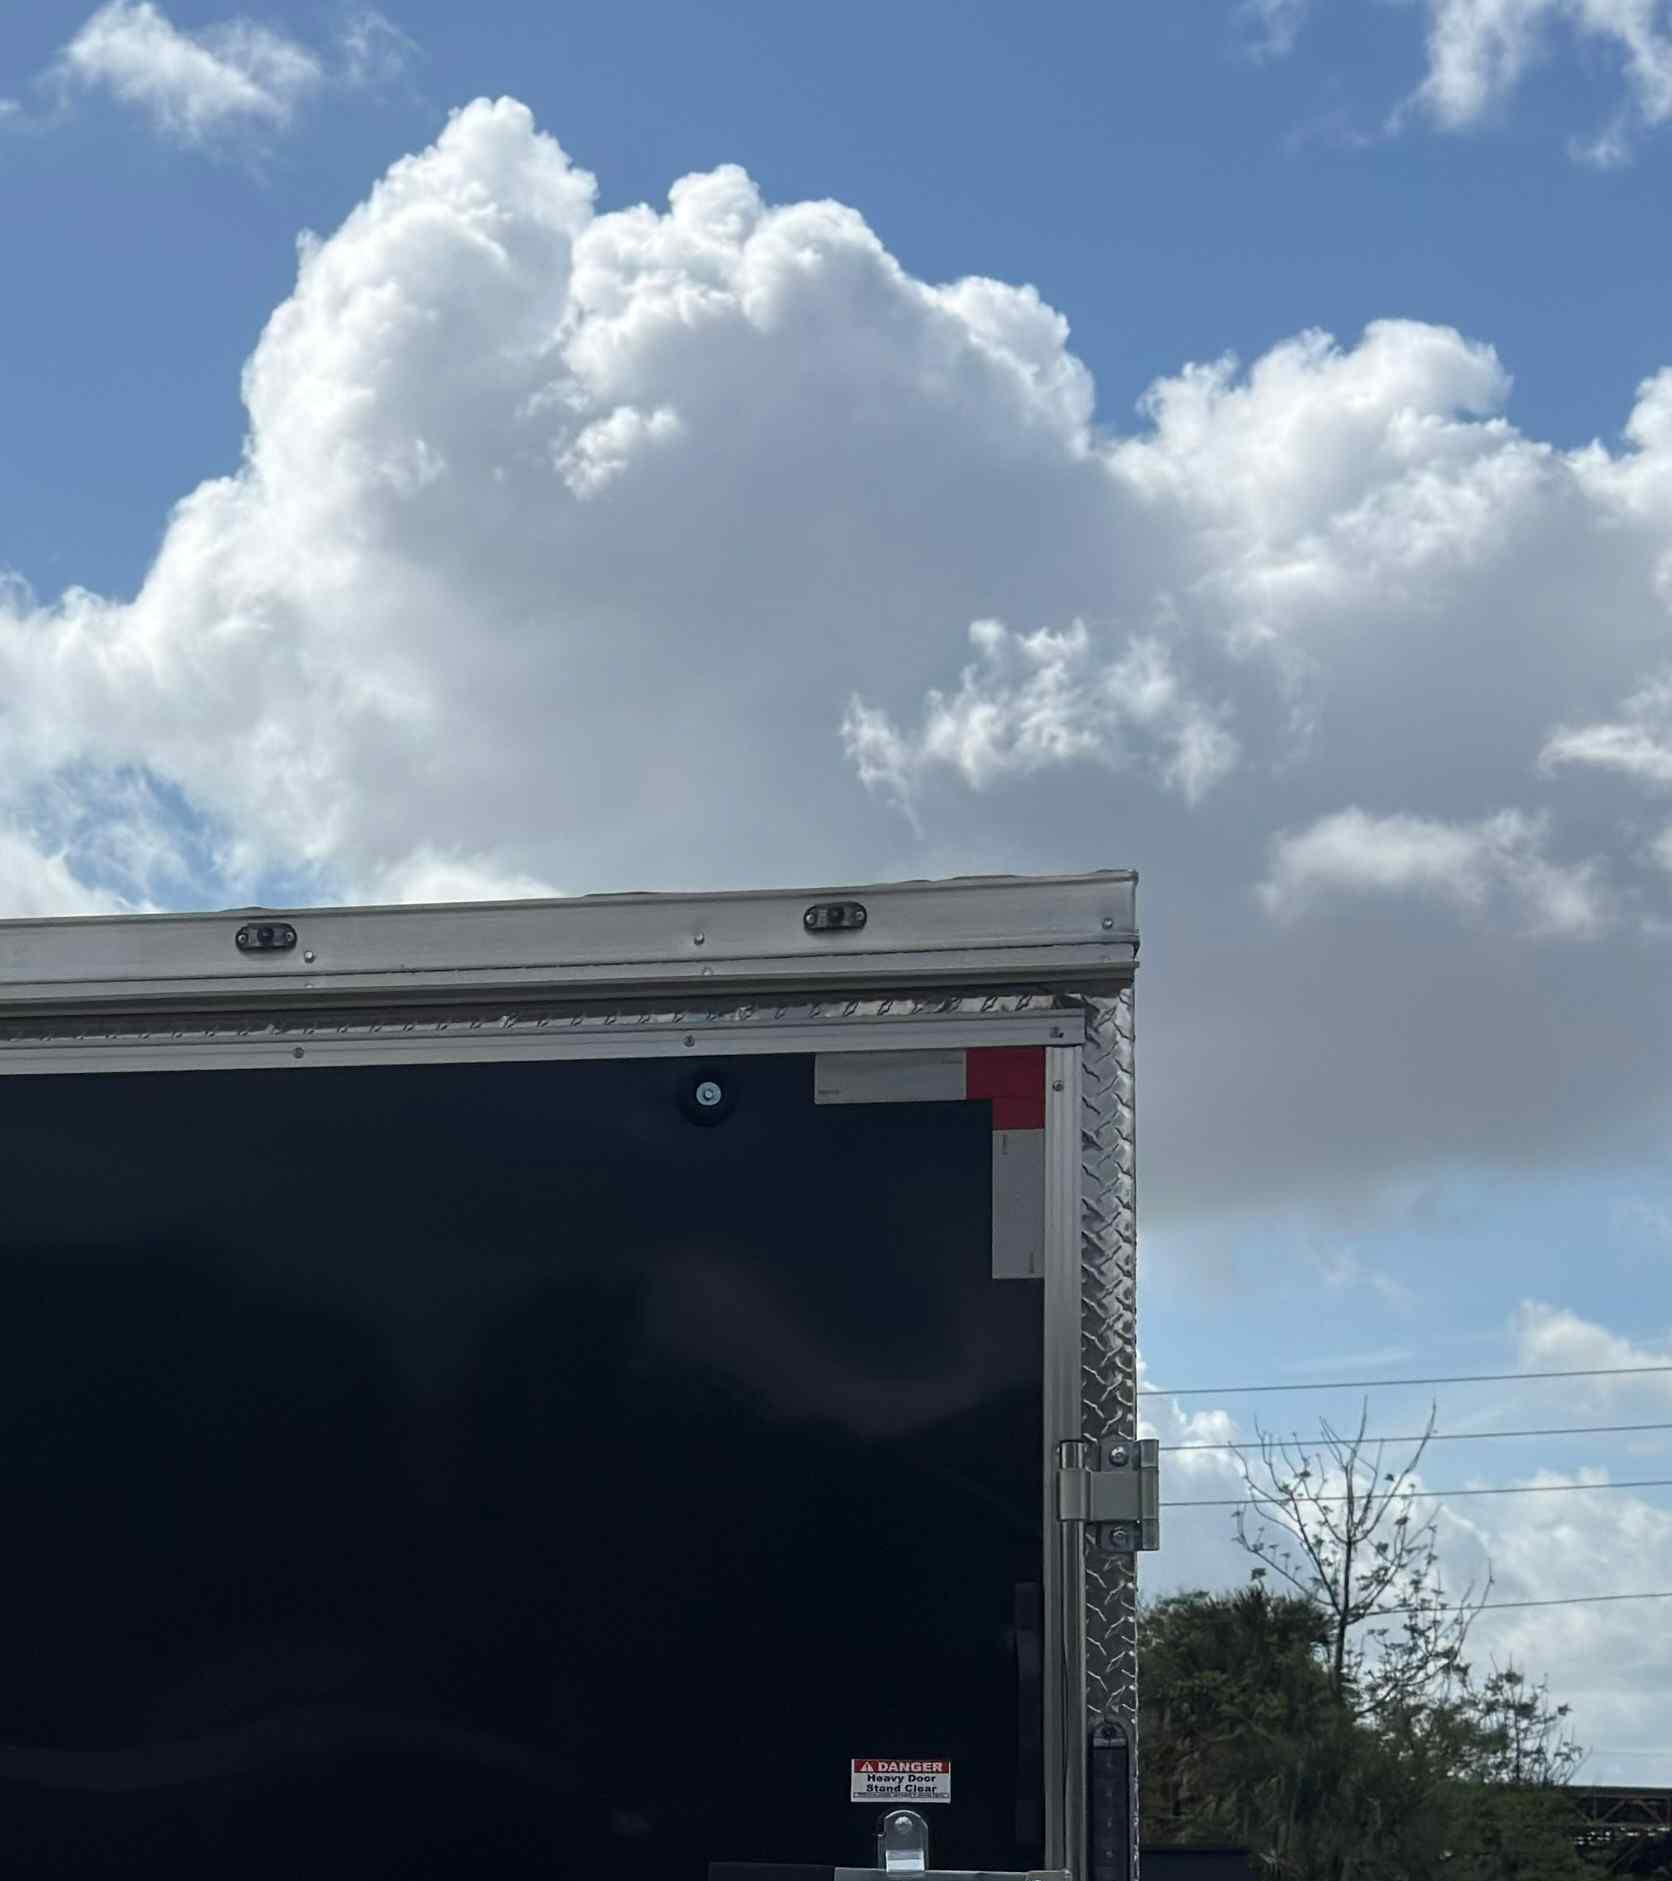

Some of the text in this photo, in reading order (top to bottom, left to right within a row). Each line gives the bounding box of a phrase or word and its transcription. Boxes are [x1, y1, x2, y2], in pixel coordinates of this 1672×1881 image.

[878, 1761, 943, 1772] DANGER
[867, 1774, 936, 1784] Heavy Door
[866, 1784, 937, 1792] Stand Clear
